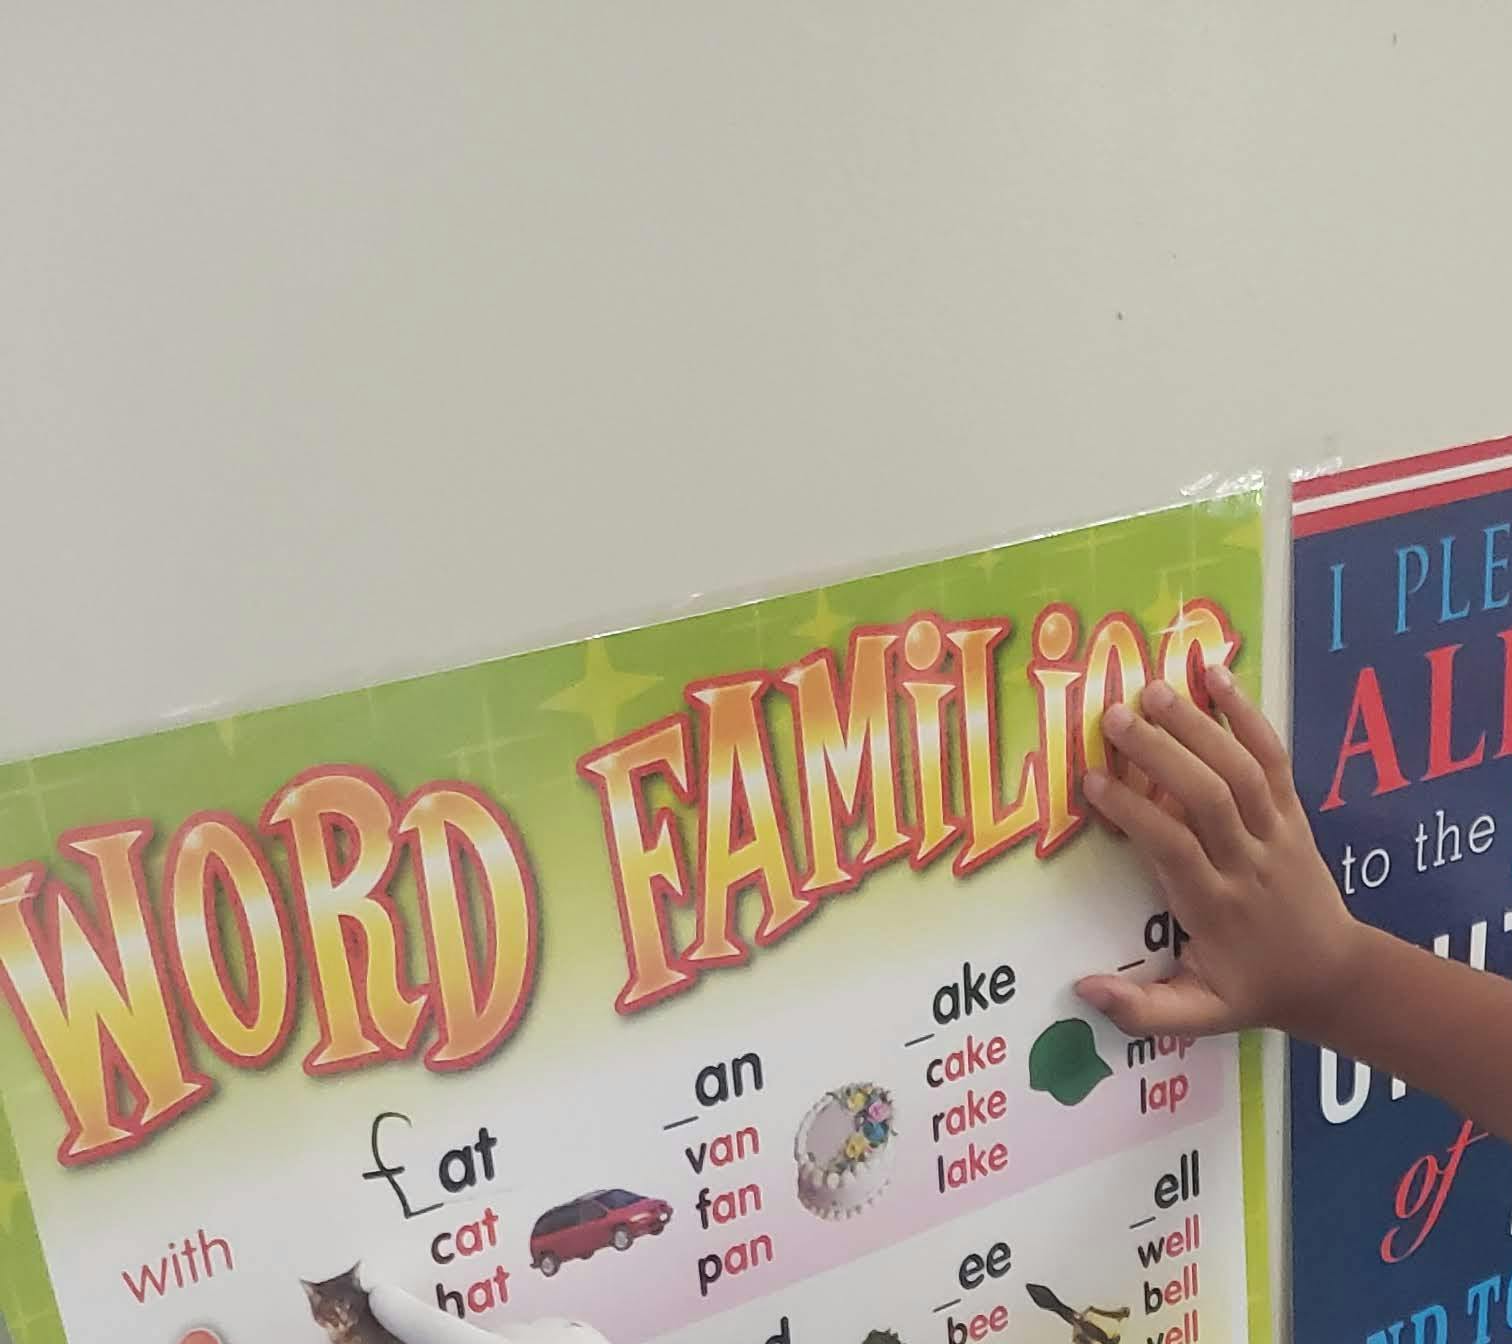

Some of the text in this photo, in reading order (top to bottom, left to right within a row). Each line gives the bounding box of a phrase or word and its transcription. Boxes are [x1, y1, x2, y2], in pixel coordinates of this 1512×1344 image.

[1328, 561, 1346, 652] I
[1342, 842, 1389, 894] to
[1415, 809, 1495, 872] the
[0, 764, 538, 1168] WORD
[926, 1035, 1007, 1088] cake
[932, 1090, 1007, 1142] rake
[1140, 1074, 1189, 1115] lap
[685, 1125, 760, 1174] van
[937, 1143, 1009, 1193] lake
[696, 1183, 762, 1230] fan
[1380, 1119, 1488, 1263] of
[431, 1208, 498, 1265] cat
[1137, 1214, 1200, 1269] well
[121, 1229, 234, 1303] with
[436, 1265, 510, 1318] hat
[698, 1235, 773, 1296] pan
[1143, 1262, 1198, 1315] bell
